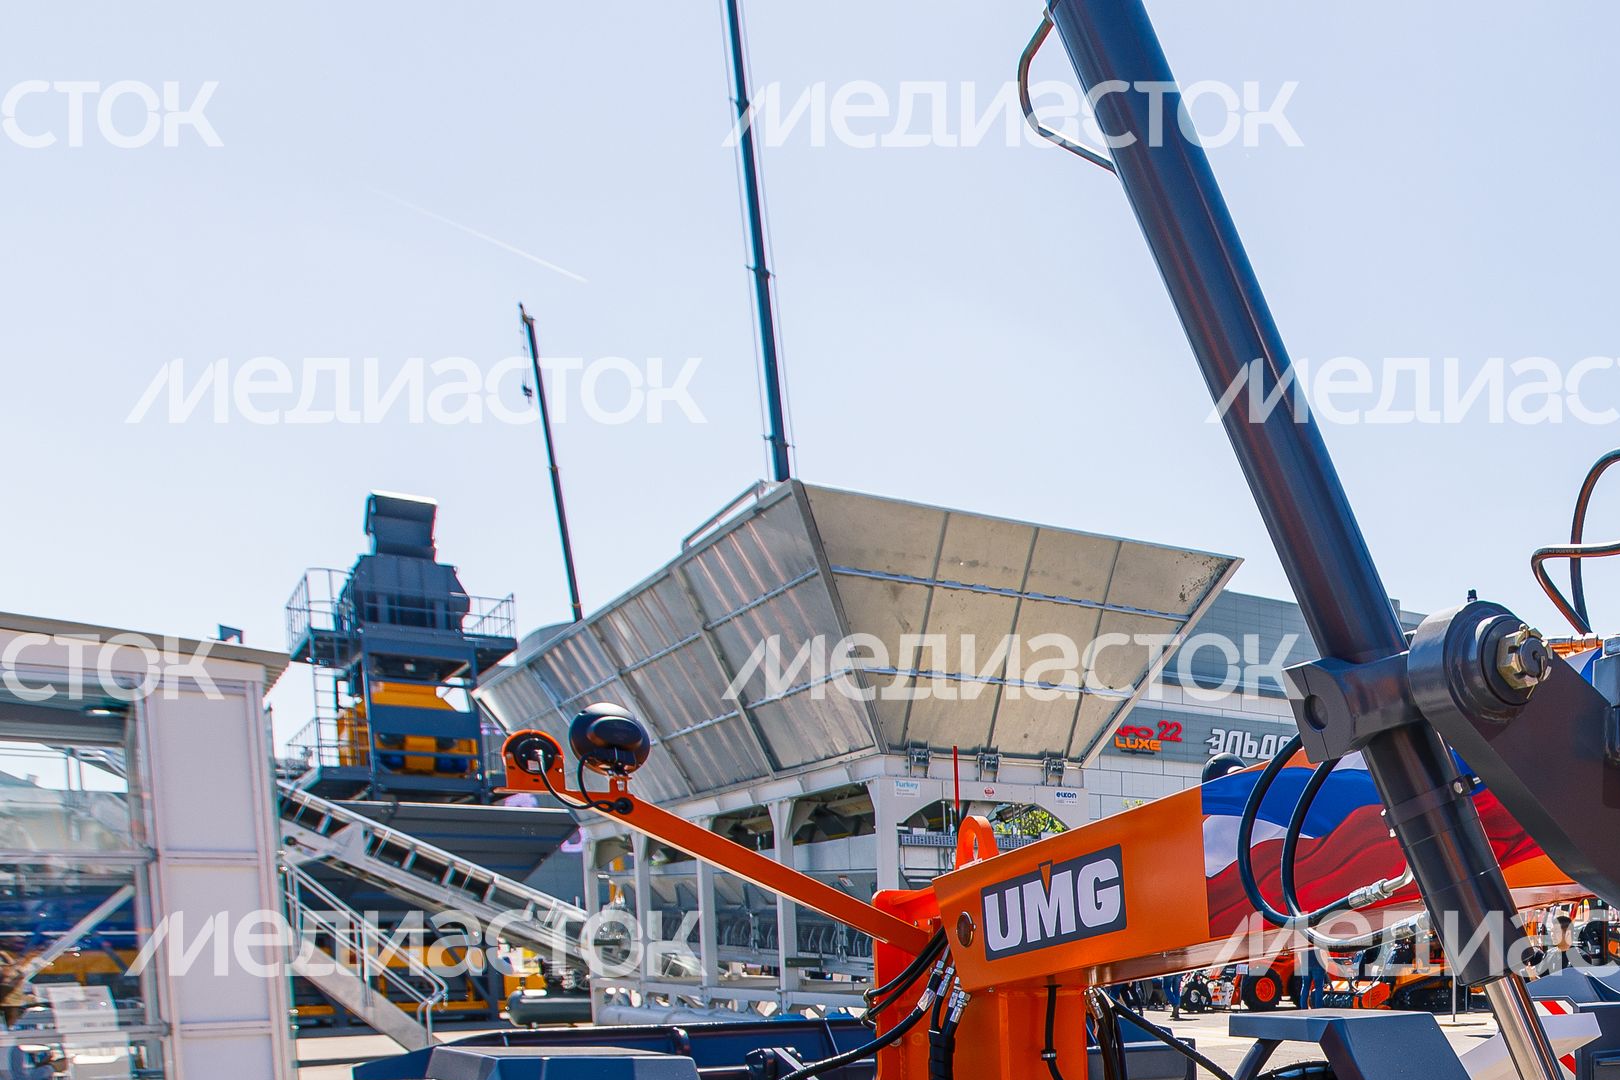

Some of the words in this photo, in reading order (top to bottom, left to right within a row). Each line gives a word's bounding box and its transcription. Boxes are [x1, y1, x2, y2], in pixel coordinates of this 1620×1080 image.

[1157, 719, 1182, 742] 22
[1114, 735, 1162, 751] LUXE
[895, 780, 919, 789] Turkey
[983, 858, 1121, 952] UMG
